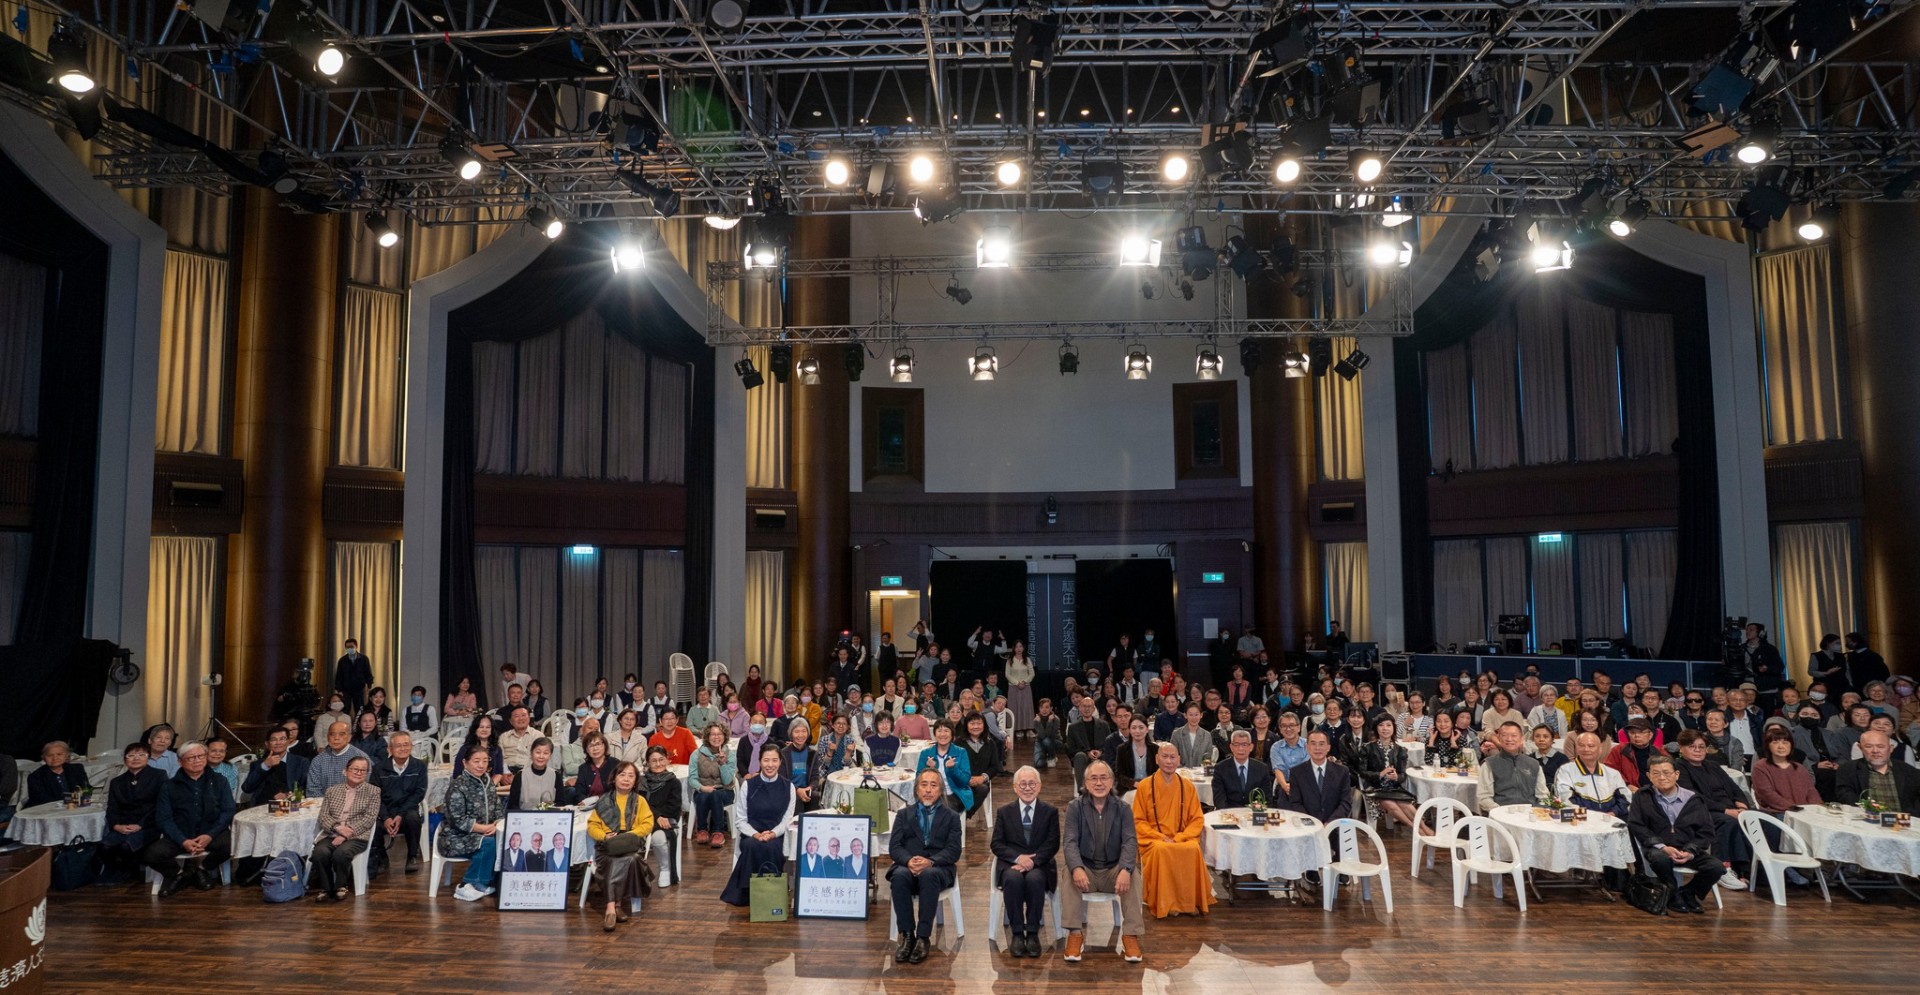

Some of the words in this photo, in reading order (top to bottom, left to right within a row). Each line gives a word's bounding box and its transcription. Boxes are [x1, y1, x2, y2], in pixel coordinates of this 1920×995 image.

[1062, 580, 1075, 670] 福田一方邀天下
[509, 880, 558, 892] 美感修行
[809, 886, 858, 898] 美感修行
